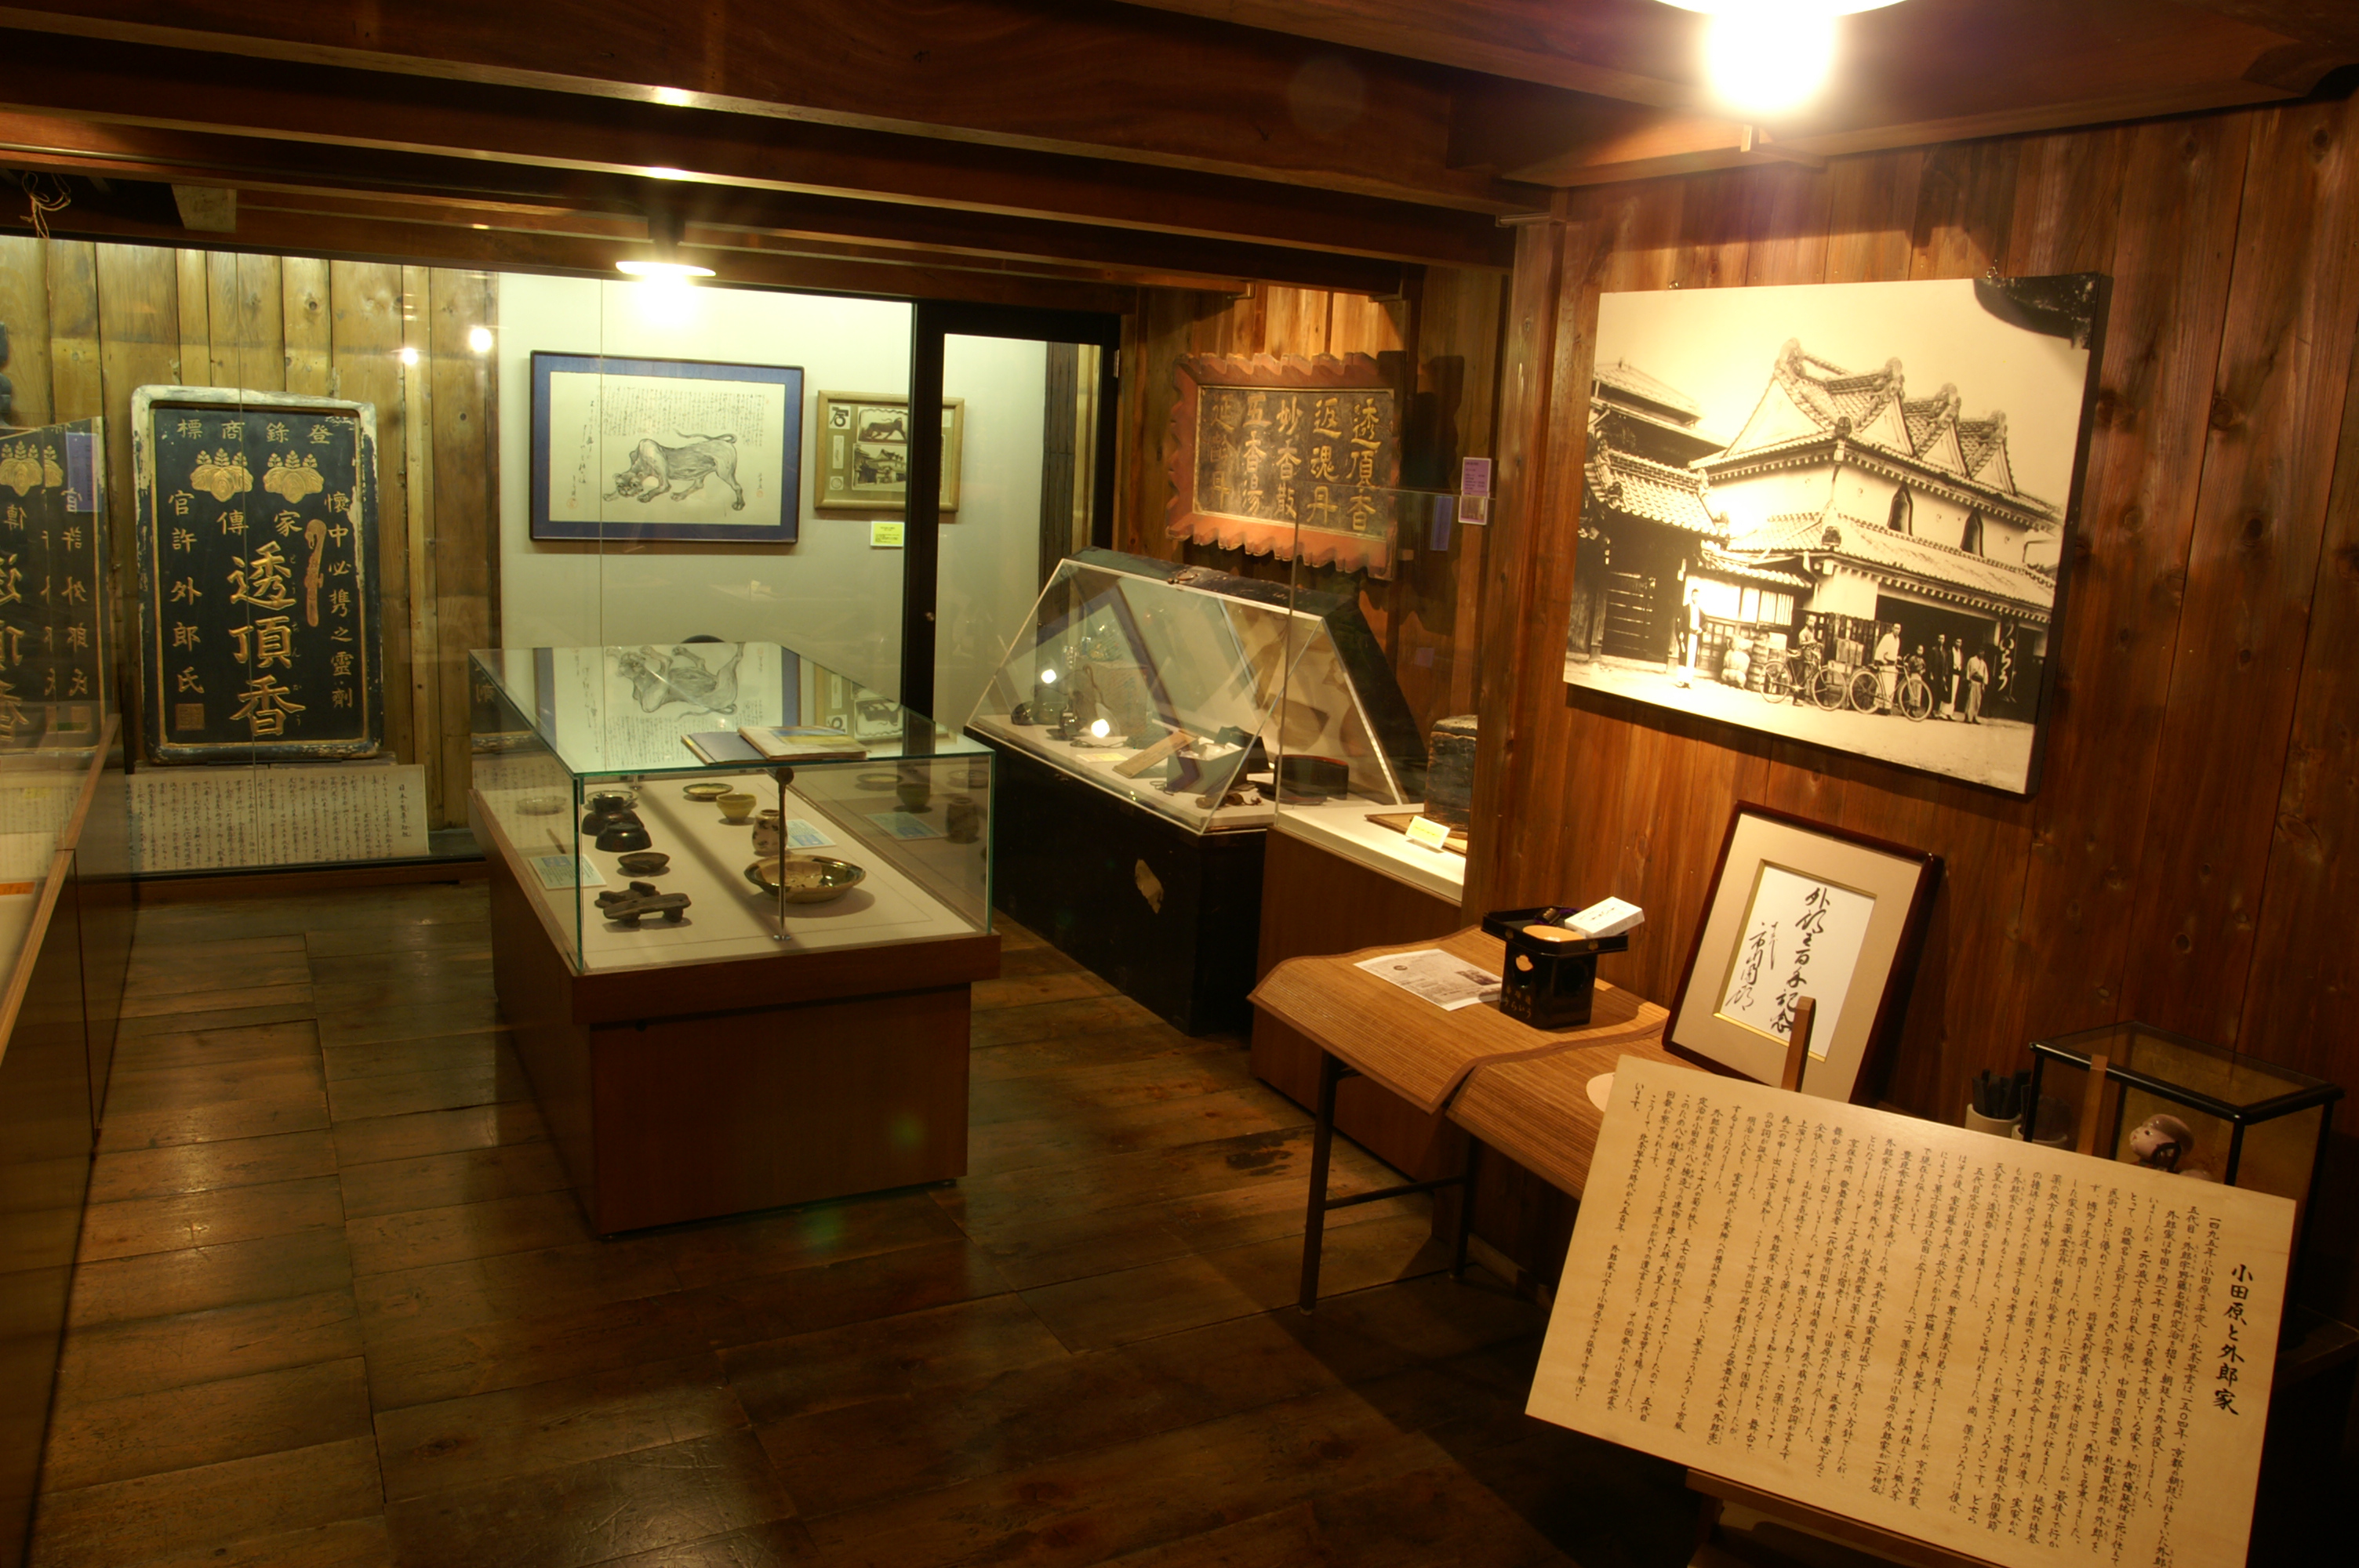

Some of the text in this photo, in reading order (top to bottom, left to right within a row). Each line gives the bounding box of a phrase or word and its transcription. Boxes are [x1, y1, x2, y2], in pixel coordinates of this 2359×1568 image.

[1241, 394, 1272, 516] 五香湯
[1345, 397, 1383, 532] 透頂香
[168, 488, 205, 694] 官許外郎氏
[227, 539, 307, 737] 透頂香
[1630, 1083, 1644, 1111] います。
[1714, 1105, 1741, 1193] するようになりました。
[1907, 1147, 1931, 1234] で現在も伝えています。
[2213, 1263, 2253, 1415] 小田原と外郎家
